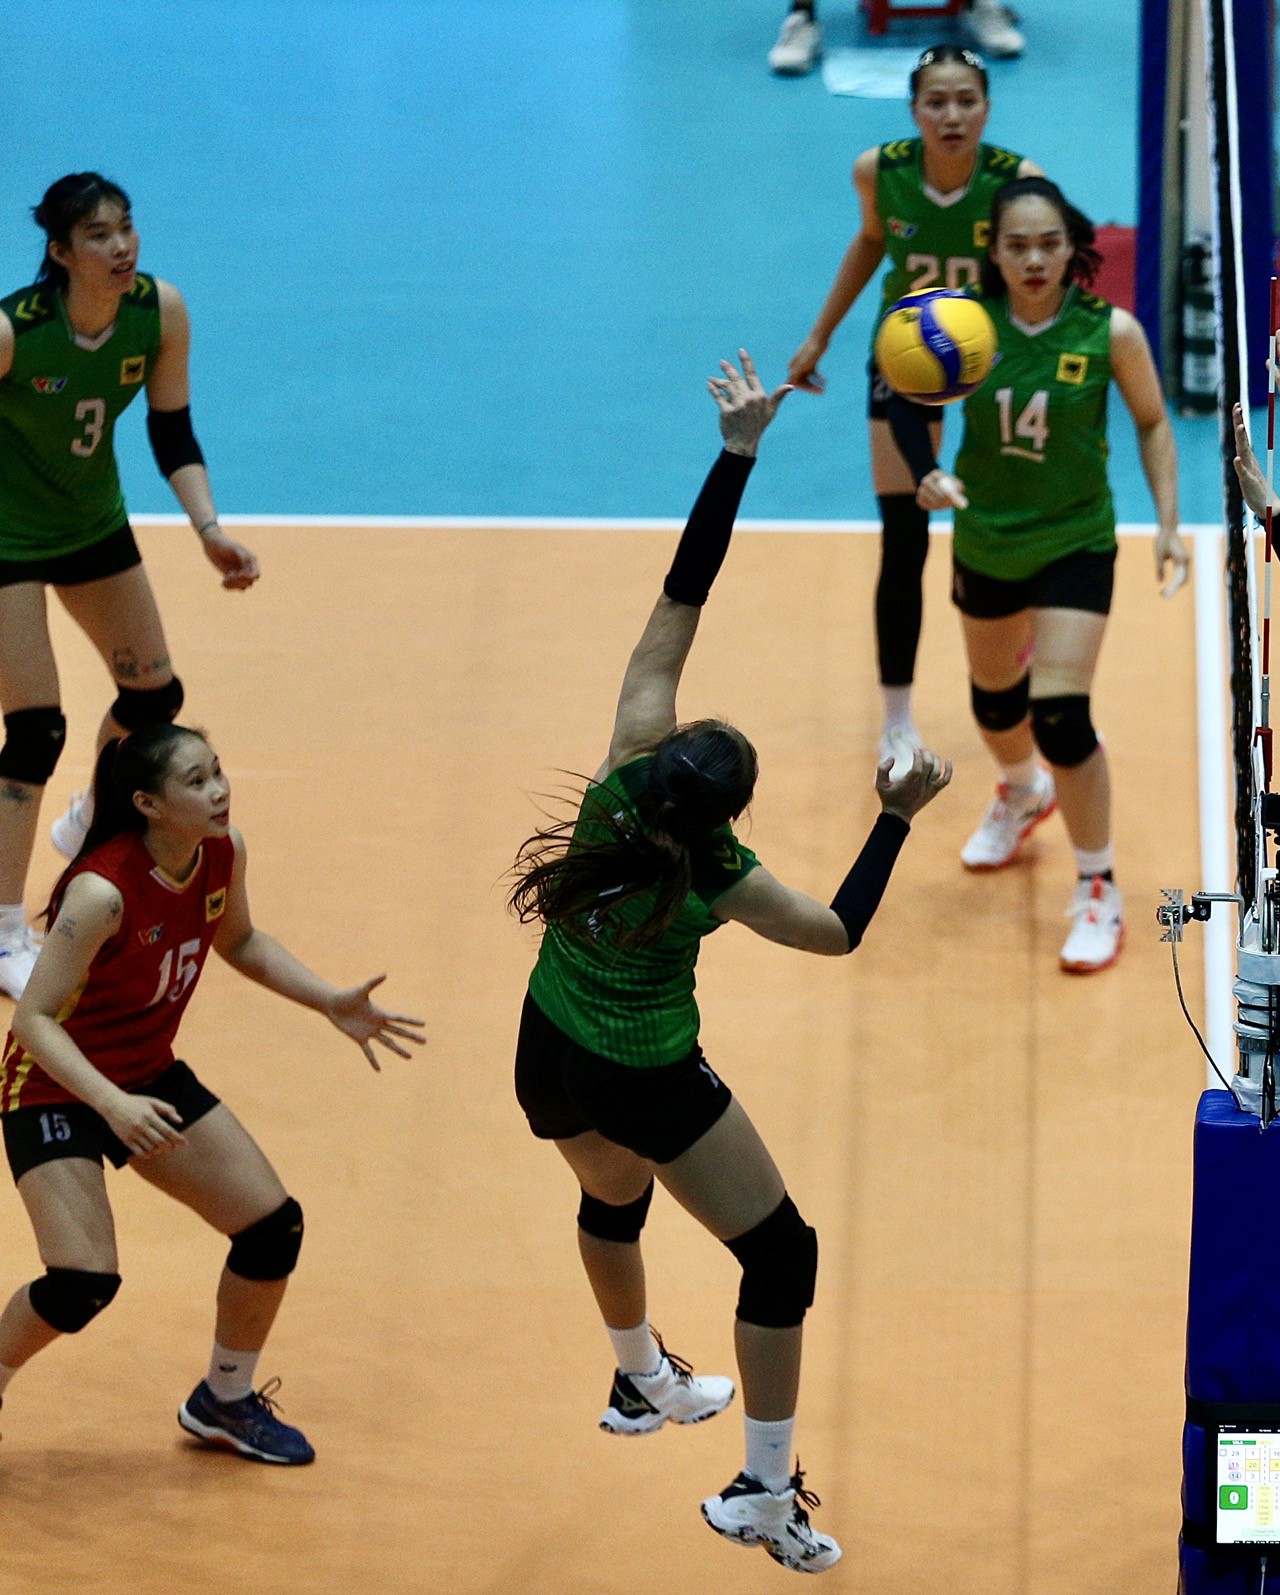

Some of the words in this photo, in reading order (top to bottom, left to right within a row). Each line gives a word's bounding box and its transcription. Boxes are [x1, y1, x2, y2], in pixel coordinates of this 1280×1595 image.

[70, 397, 106, 458] 3
[995, 387, 1049, 450] 14
[145, 937, 202, 1008] 15
[38, 1112, 72, 1144] 15
